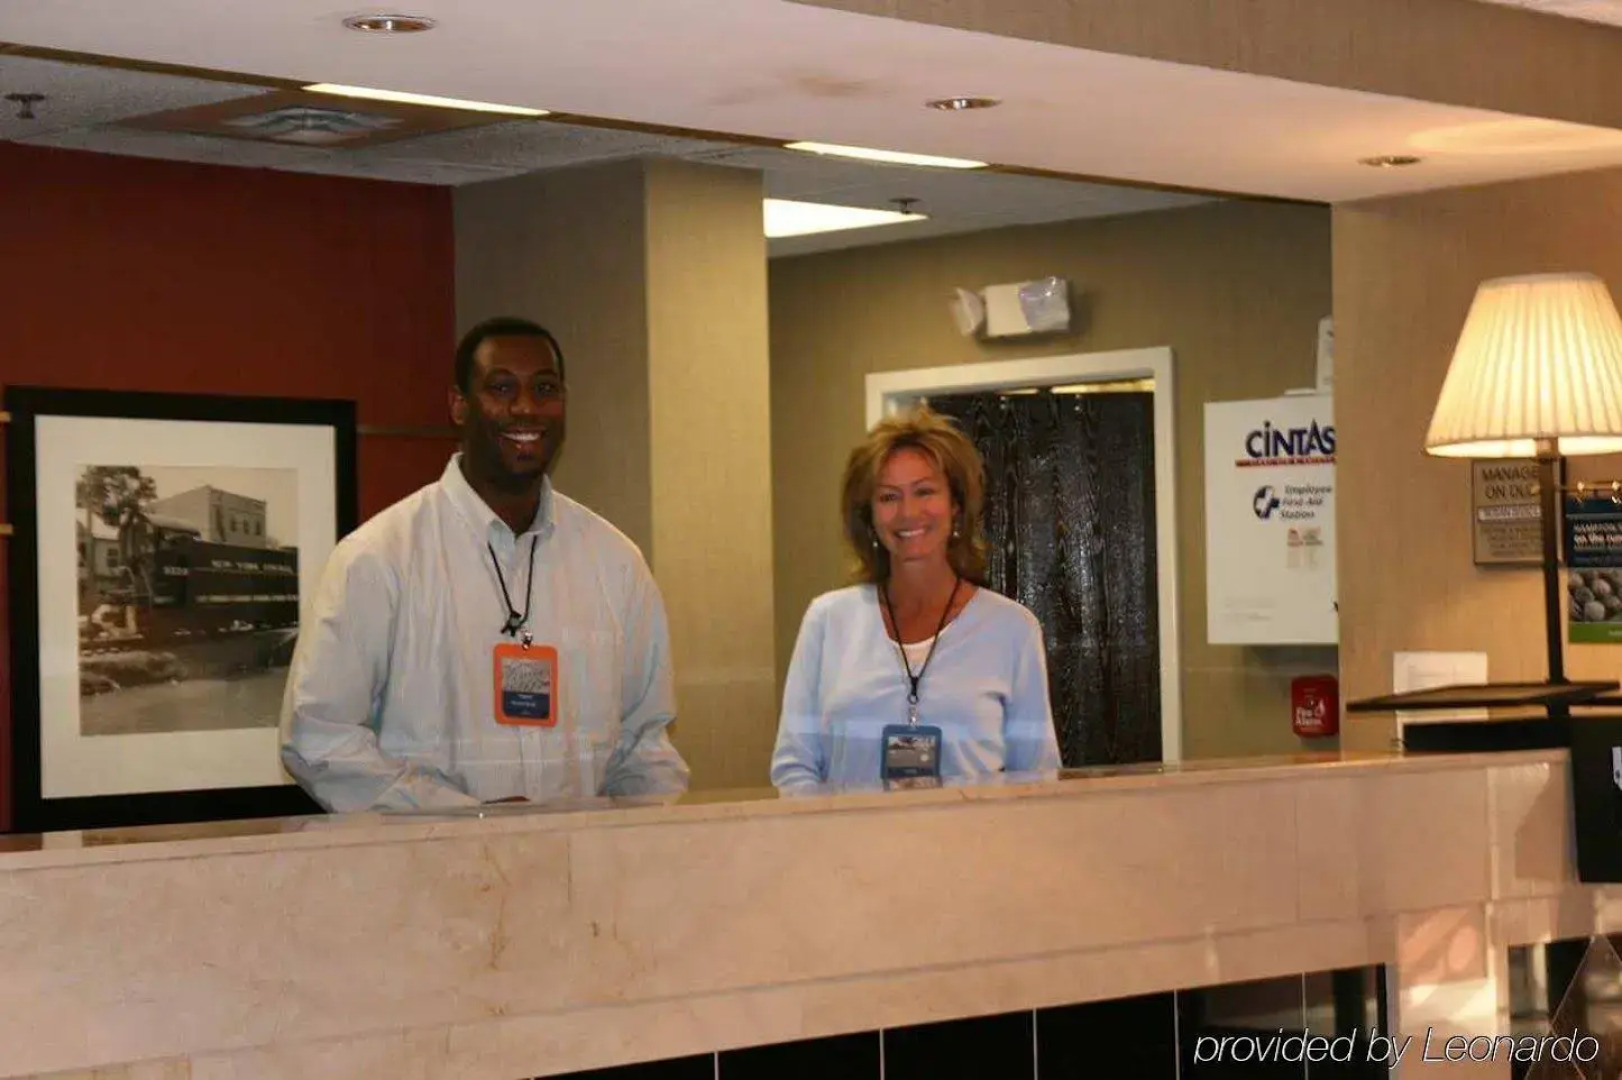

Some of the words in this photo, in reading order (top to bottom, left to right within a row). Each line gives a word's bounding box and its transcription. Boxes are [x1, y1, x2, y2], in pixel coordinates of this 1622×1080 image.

[1482, 466, 1541, 481] MANAGE
[1284, 485, 1332, 496] Employee
[1485, 484, 1505, 499] ON
[1280, 510, 1316, 520] Station
